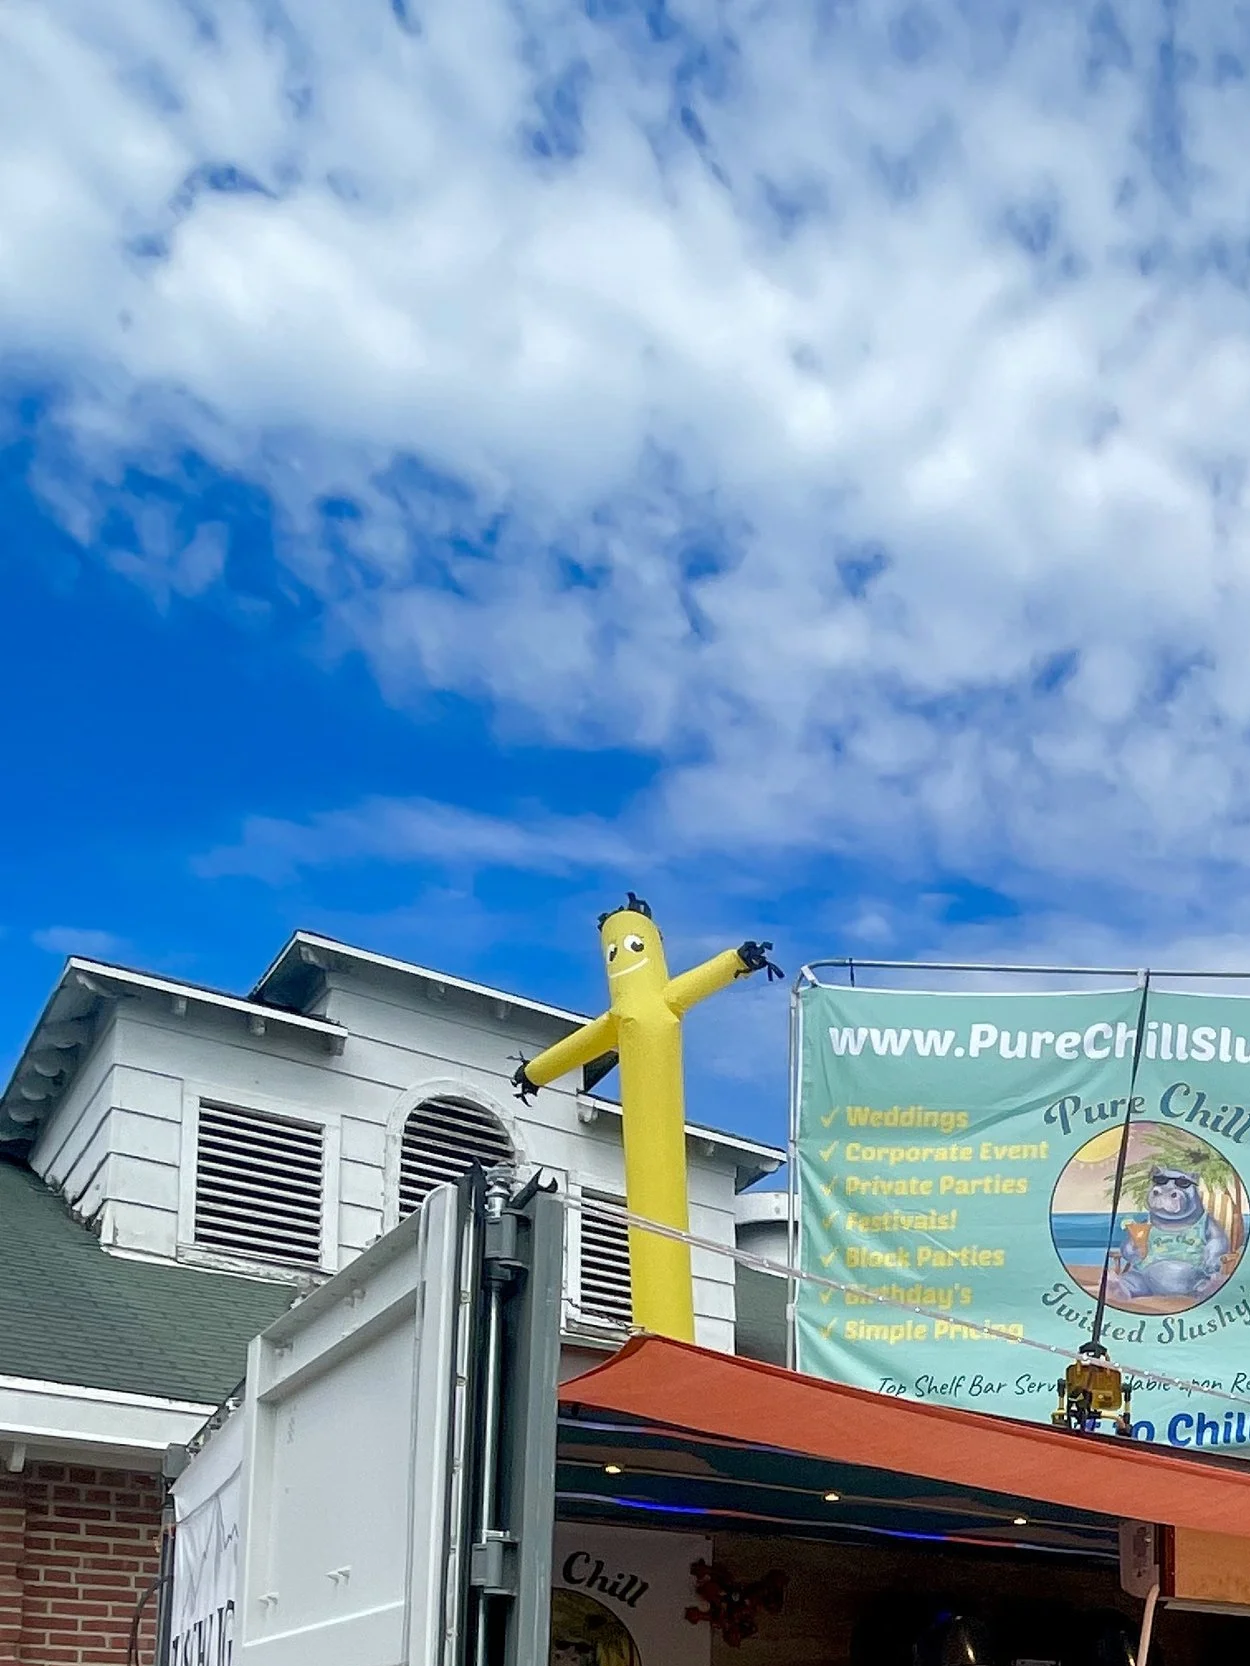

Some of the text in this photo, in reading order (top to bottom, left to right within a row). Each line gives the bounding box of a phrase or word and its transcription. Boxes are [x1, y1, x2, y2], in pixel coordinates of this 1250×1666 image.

[845, 1105, 969, 1134] Weddings
[1043, 1094, 1146, 1136] Pure
[845, 1141, 1049, 1165] Corporate Event
[845, 1174, 1029, 1196] Private Parties
[845, 1208, 959, 1232] Festivals!
[845, 1245, 1006, 1268] Block Parties
[844, 1319, 1025, 1344] Simple Pricing
[877, 1377, 907, 1394] Top
[915, 1374, 967, 1398] Shelf
[968, 1374, 1008, 1396] Bar
[561, 1551, 650, 1608] Chill
